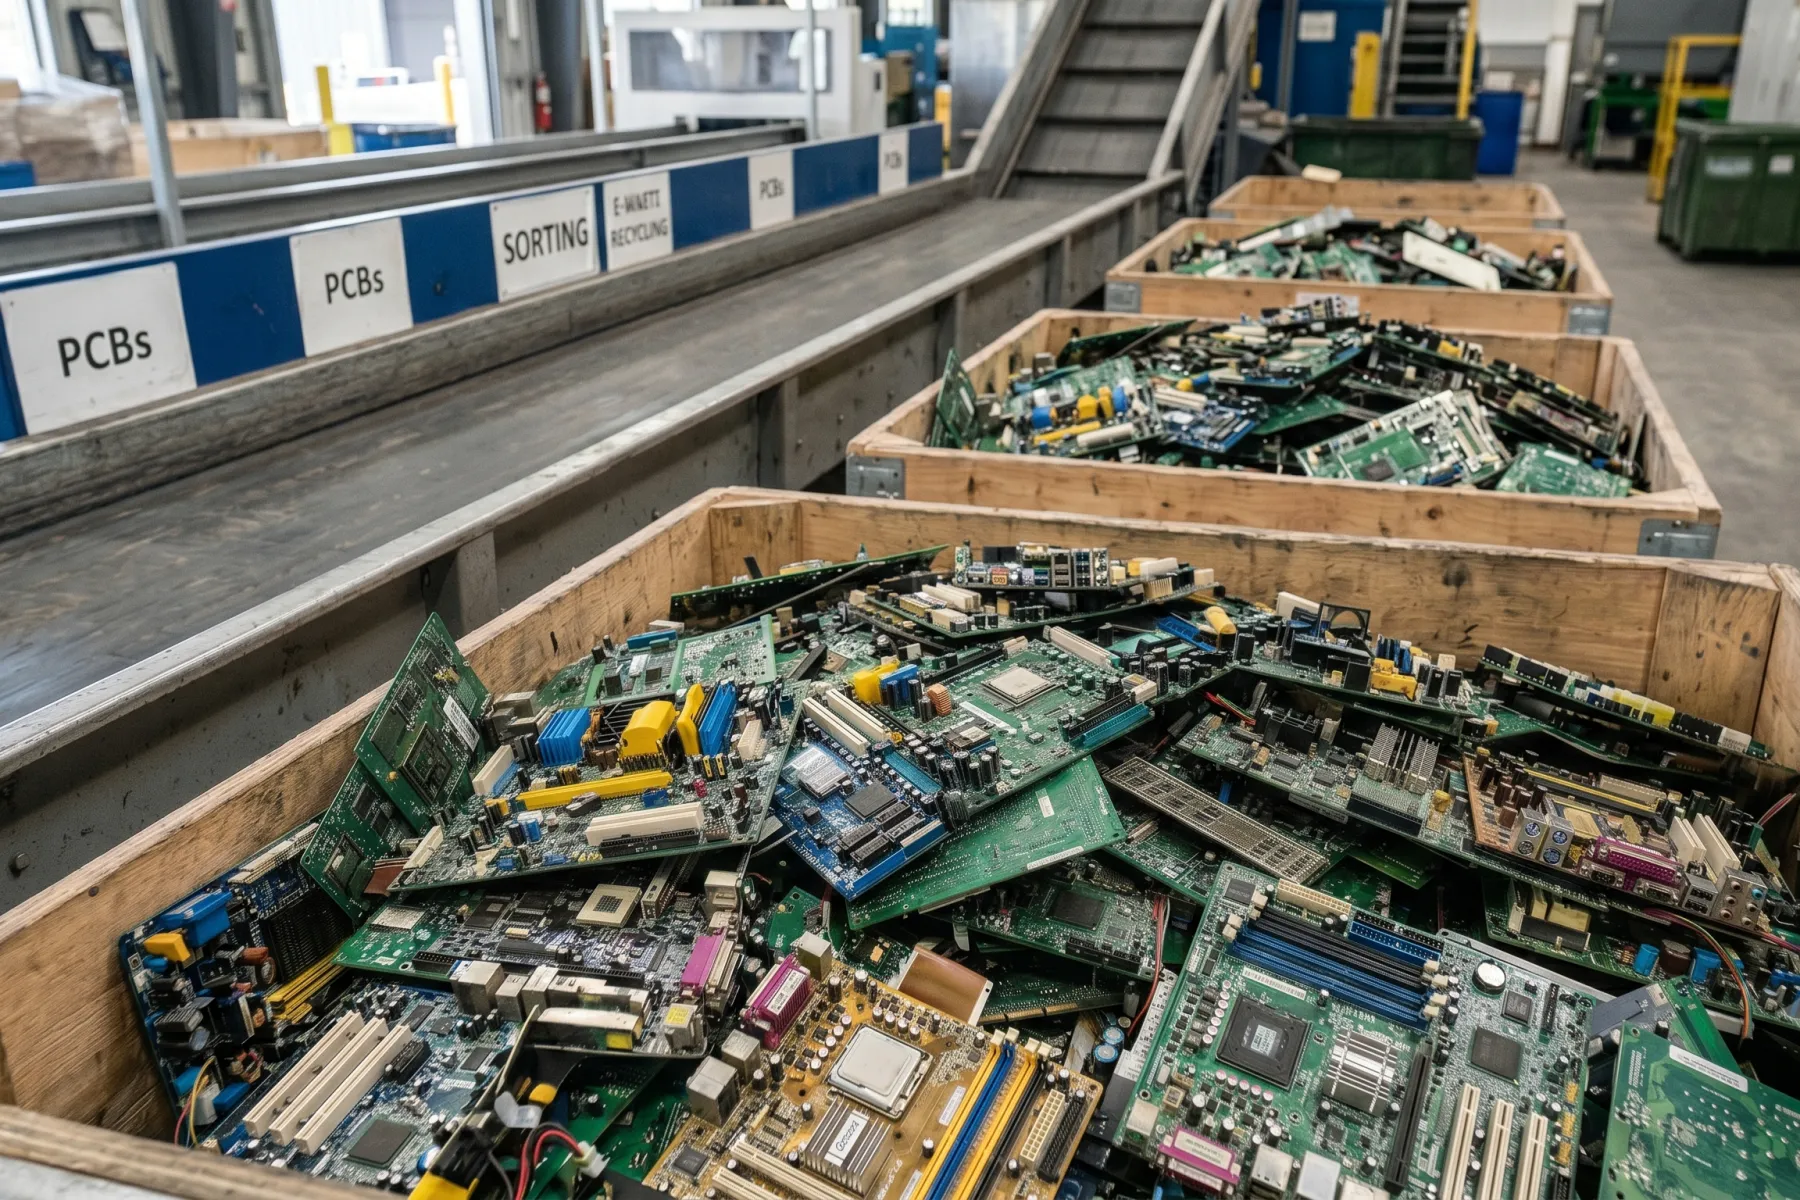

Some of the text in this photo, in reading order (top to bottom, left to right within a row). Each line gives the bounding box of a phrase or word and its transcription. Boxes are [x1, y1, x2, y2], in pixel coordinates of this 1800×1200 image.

[503, 217, 589, 265] SORTING
[324, 265, 385, 305] PCBs
[57, 326, 153, 378] PCBs
